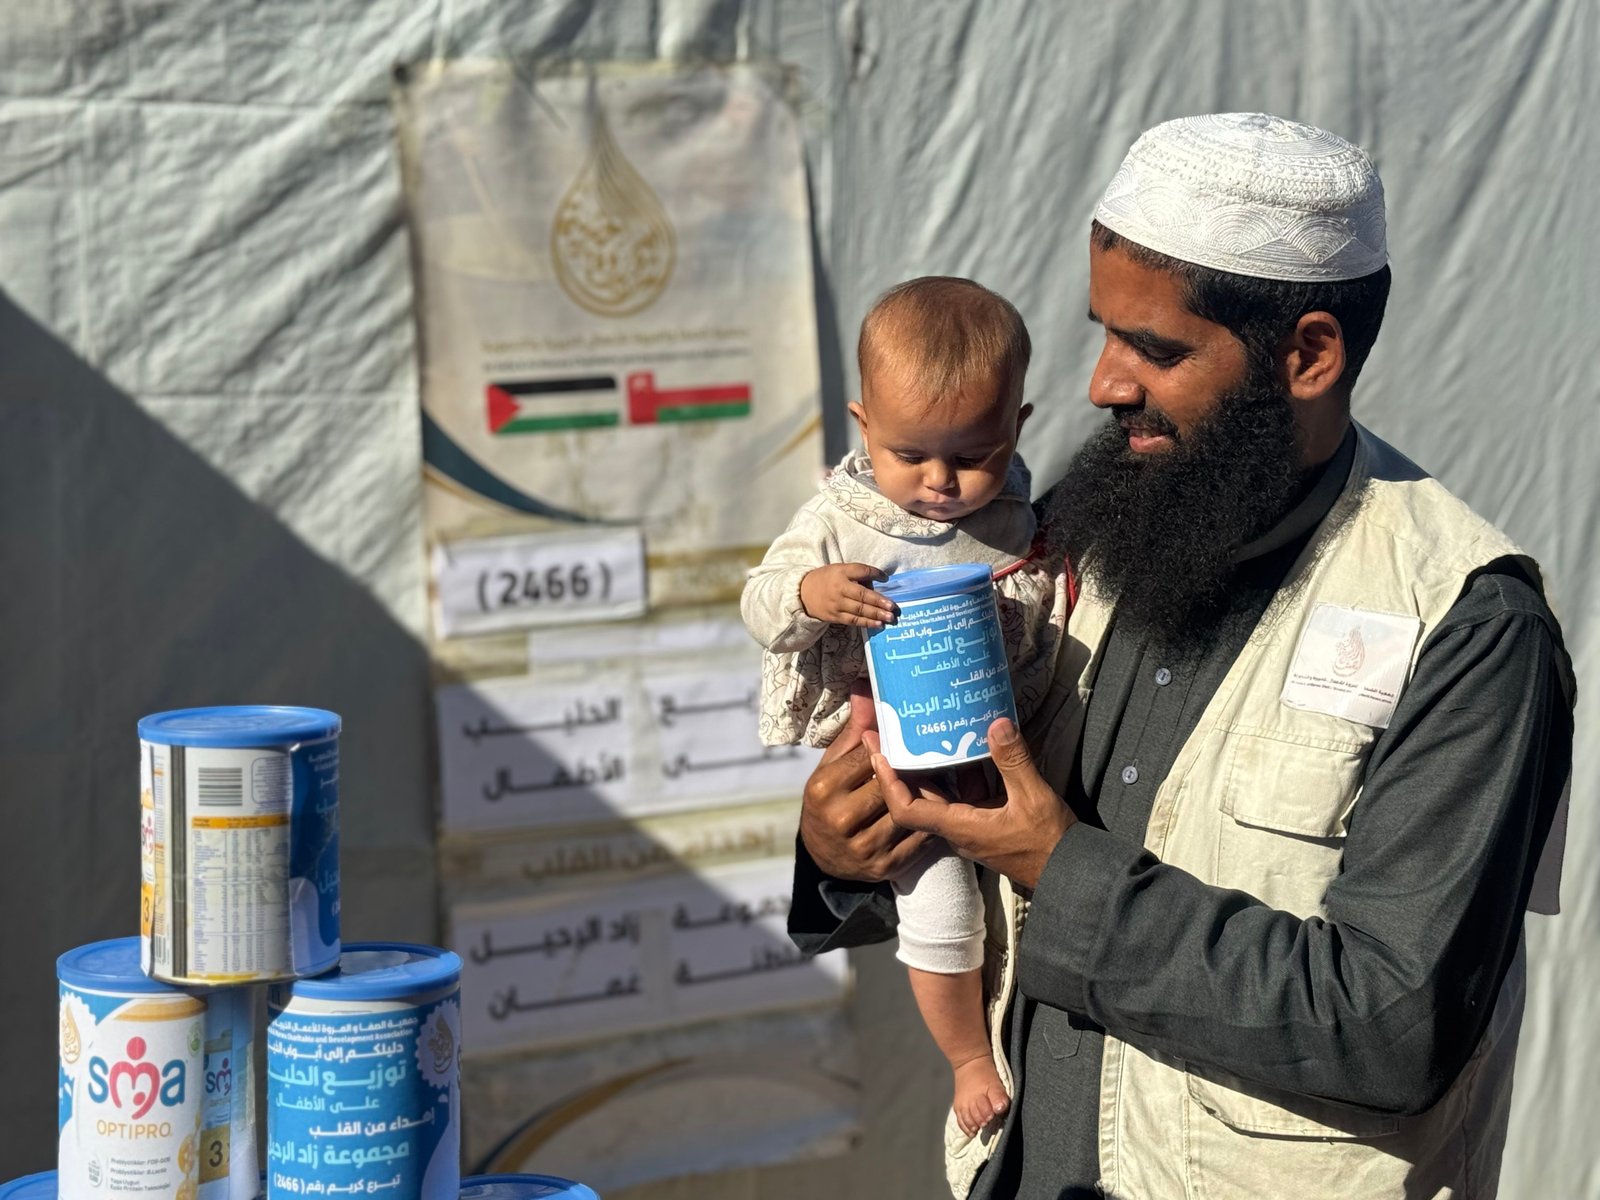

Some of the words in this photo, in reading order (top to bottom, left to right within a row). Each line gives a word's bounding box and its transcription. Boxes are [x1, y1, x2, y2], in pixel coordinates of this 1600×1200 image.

[476, 562, 612, 612] (2466)
[916, 620, 953, 638] أبواب
[954, 618, 967, 630] إلى
[886, 629, 915, 643] الخير
[885, 636, 953, 664] الحليب
[963, 650, 991, 667] على
[911, 656, 960, 677] الأطفال
[950, 668, 984, 688] القلب
[942, 692, 960, 711] زاد
[964, 680, 1008, 704] مجموعة
[898, 695, 939, 718] الرحيل
[954, 718, 968, 730] رقم
[969, 709, 991, 727] كريم
[916, 720, 953, 737] (2466)
[322, 1022, 352, 1035] المروة
[359, 1019, 386, 1032] الصفا
[315, 1034, 327, 1043] and
[328, 1033, 374, 1044] Development
[375, 1028, 414, 1040] Association
[284, 1043, 322, 1062] أبواب
[323, 1045, 343, 1064] إلى
[345, 1041, 404, 1063] دليلكم
[205, 1069, 232, 1096] sm
[322, 1058, 407, 1095] توزيع
[88, 1055, 186, 1120] sma
[330, 1095, 380, 1114] على
[388, 1106, 436, 1131] إهداء
[96, 1119, 171, 1139] OPTIPRO
[308, 1121, 361, 1139] القلب
[364, 1122, 386, 1136] من
[209, 1140, 223, 1168] 3
[297, 1142, 318, 1170] زاد
[323, 1141, 409, 1169] مجموعة
[306, 1179, 325, 1194] رقم
[326, 1179, 364, 1195] كريم
[366, 1174, 401, 1193] تبرع
